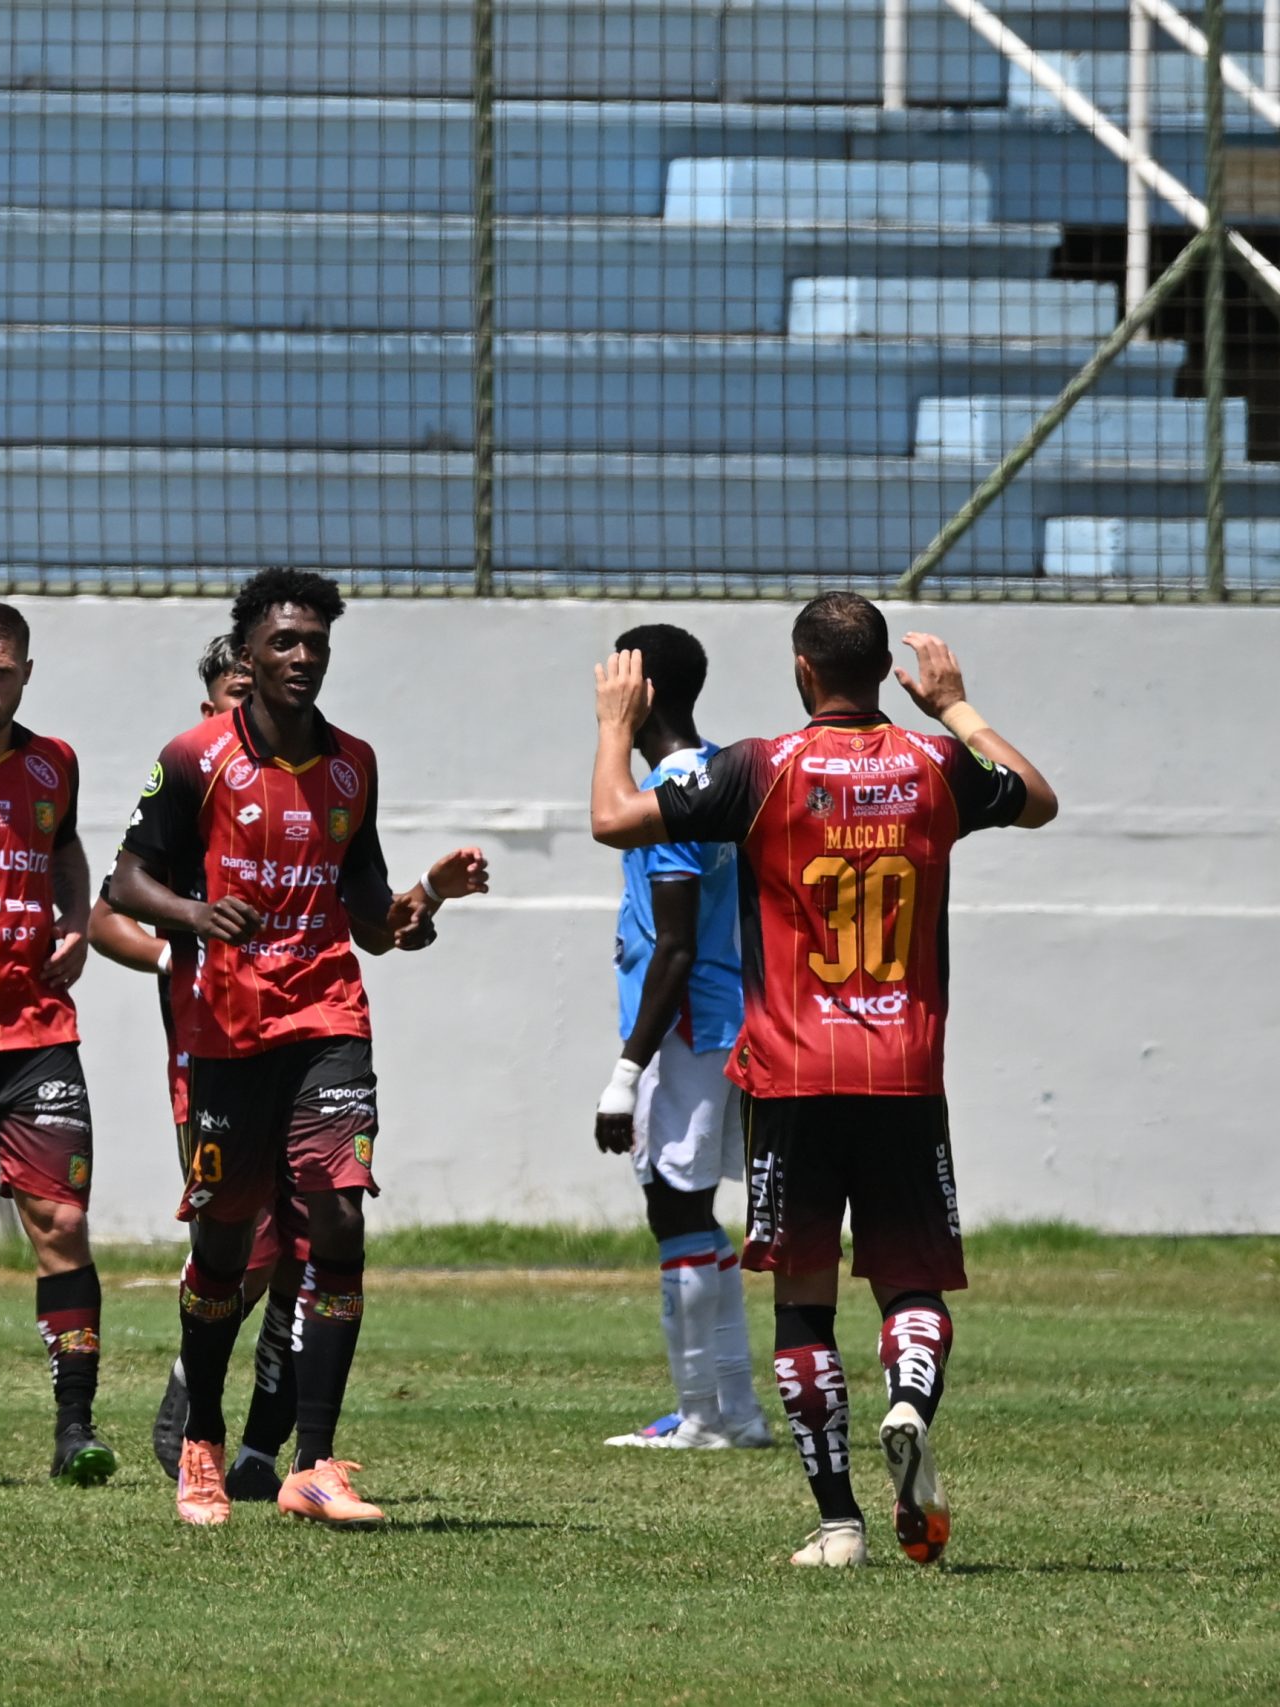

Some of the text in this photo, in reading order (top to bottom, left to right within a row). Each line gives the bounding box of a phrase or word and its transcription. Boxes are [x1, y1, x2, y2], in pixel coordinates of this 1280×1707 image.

[853, 782, 919, 804] UEAS
[826, 824, 906, 849] MACCARI
[221, 855, 257, 870] banco
[240, 868, 257, 881] del
[801, 855, 917, 983] 30
[813, 994, 903, 1015] YUKO
[748, 1151, 775, 1243] RIVAL
[889, 1310, 942, 1398] ROLAND
